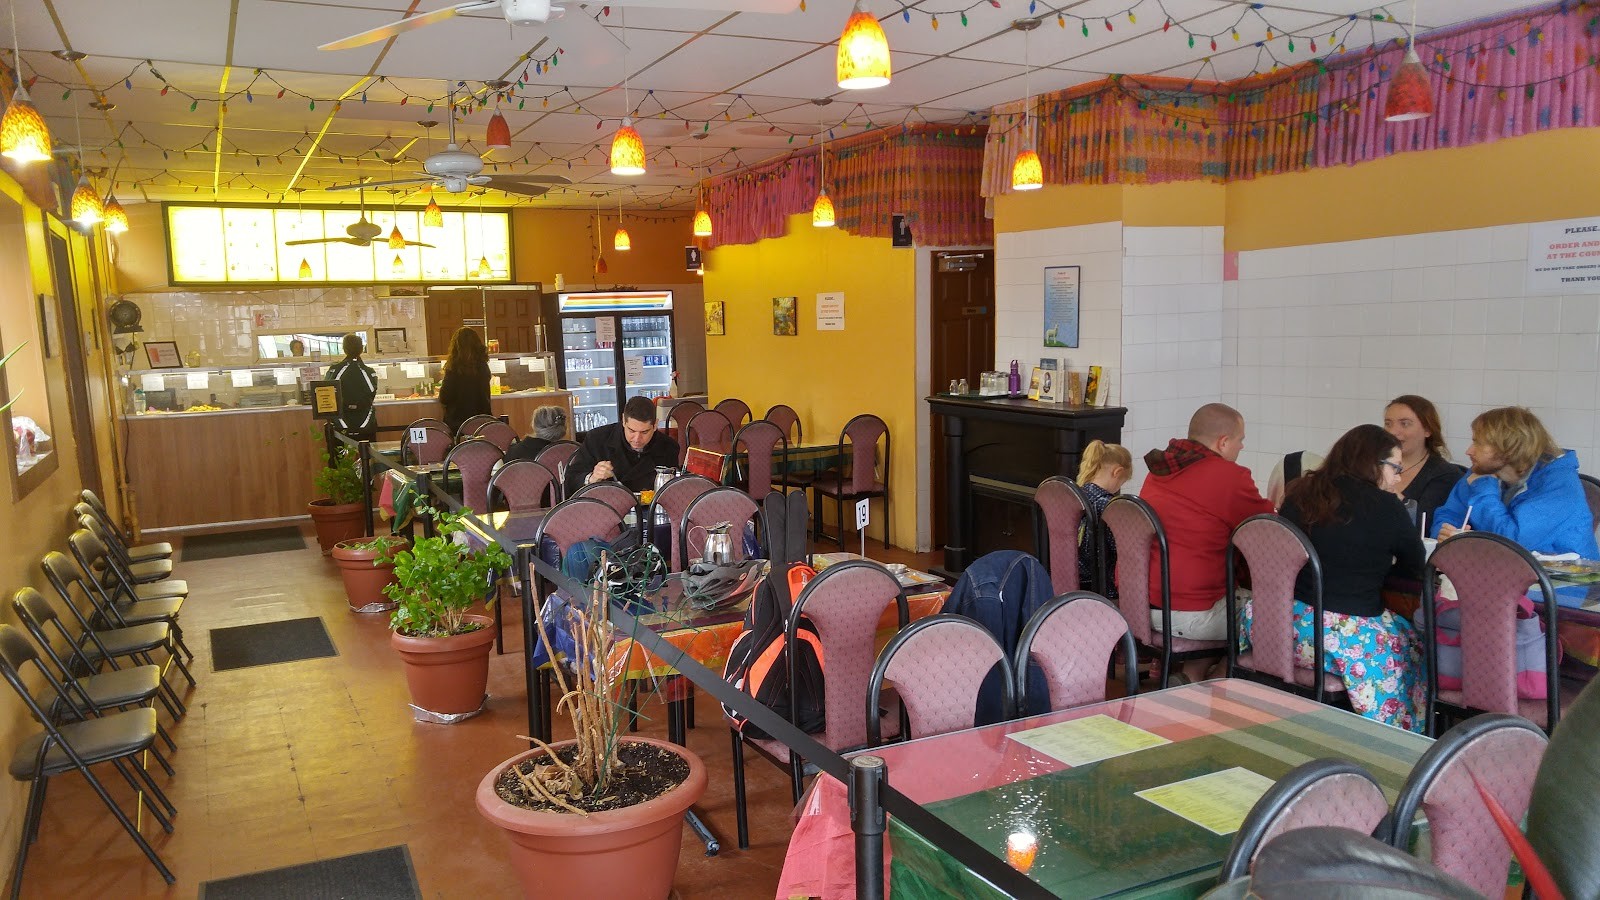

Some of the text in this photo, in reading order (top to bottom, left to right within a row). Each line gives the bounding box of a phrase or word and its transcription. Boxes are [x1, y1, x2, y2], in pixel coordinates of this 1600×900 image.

[1549, 242, 1580, 250] ORDER
[413, 430, 424, 441] 14
[858, 504, 867, 524] 19
